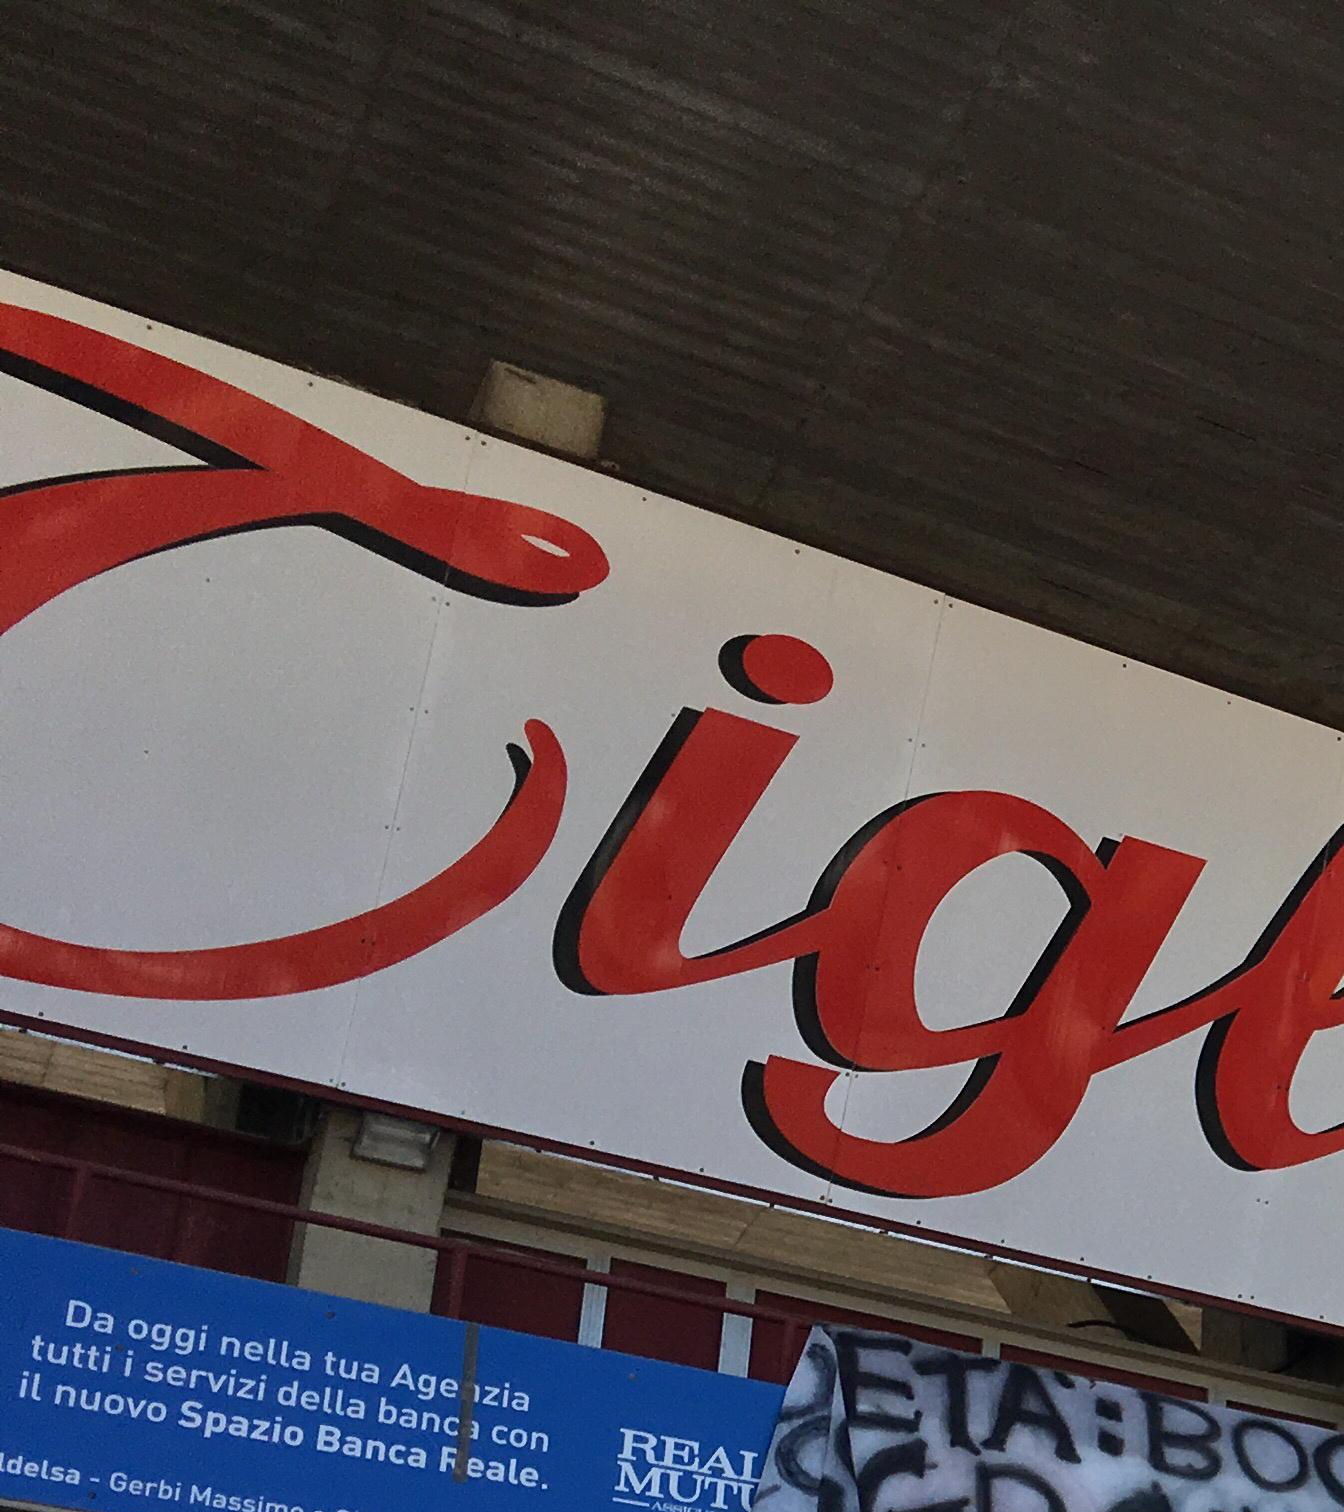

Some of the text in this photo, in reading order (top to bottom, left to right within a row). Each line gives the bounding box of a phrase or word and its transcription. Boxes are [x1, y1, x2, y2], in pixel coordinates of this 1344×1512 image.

[31, 1334, 550, 1452] tutti i servizi della banca con
[65, 1299, 530, 1412] Da oggi nella tua Agenzia
[19, 1370, 549, 1490] il nuovo Spazio Banca Reale.
[109, 1471, 182, 1502] Gerbi
